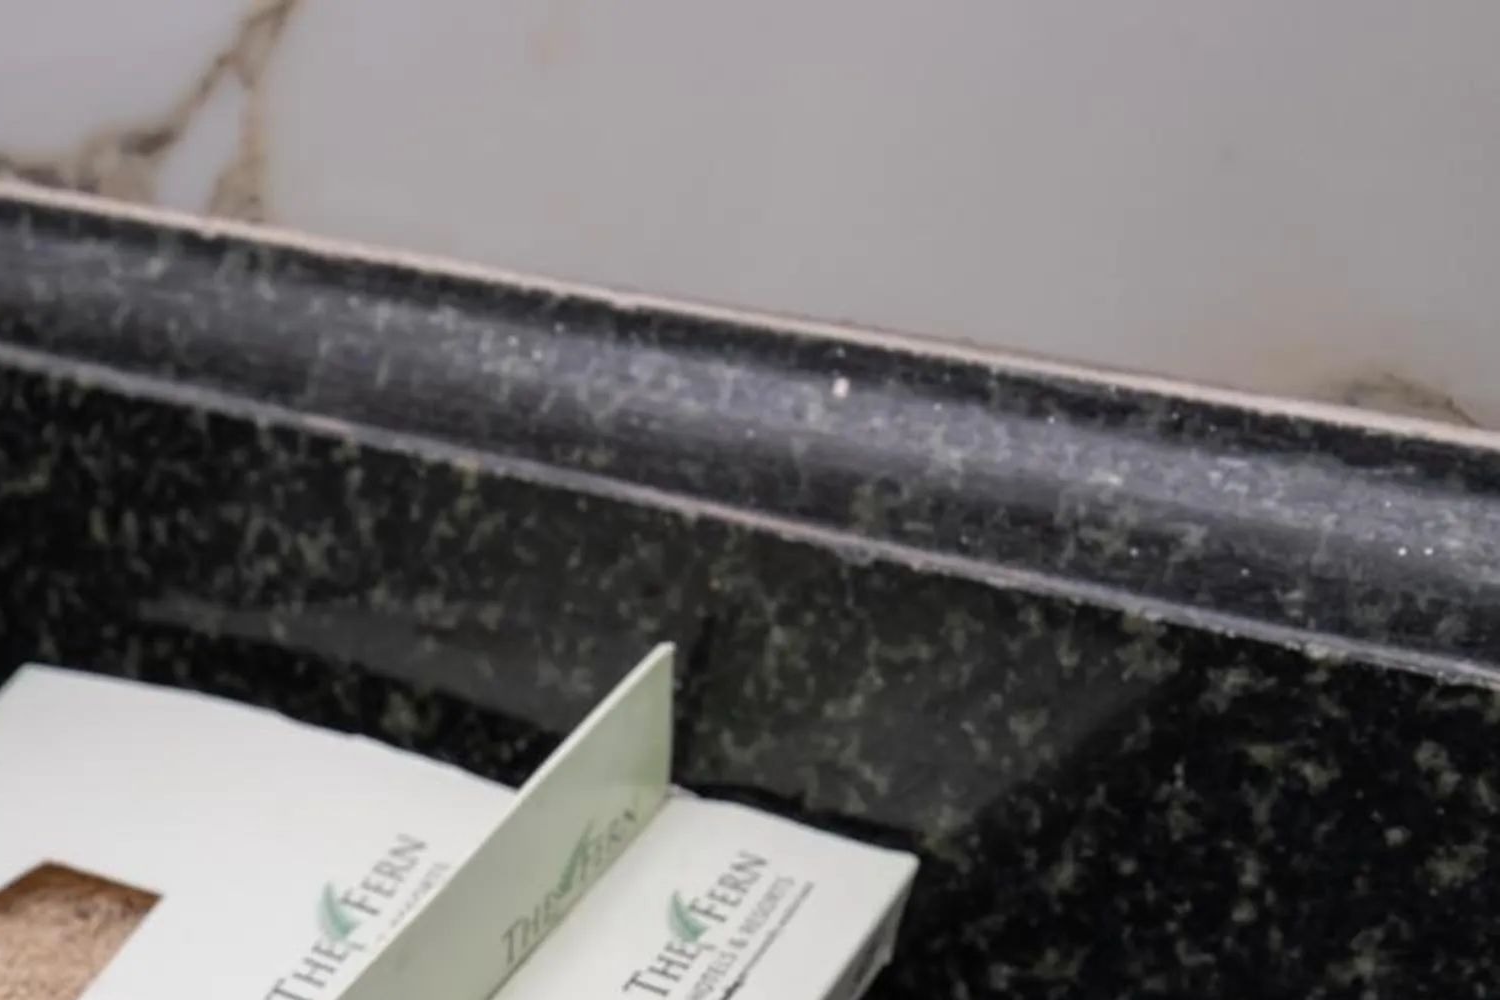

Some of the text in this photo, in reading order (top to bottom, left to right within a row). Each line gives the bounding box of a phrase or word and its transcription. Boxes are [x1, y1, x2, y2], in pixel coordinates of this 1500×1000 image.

[339, 832, 428, 917] FERN
[622, 940, 700, 998] THE
[687, 850, 768, 924] FERN
